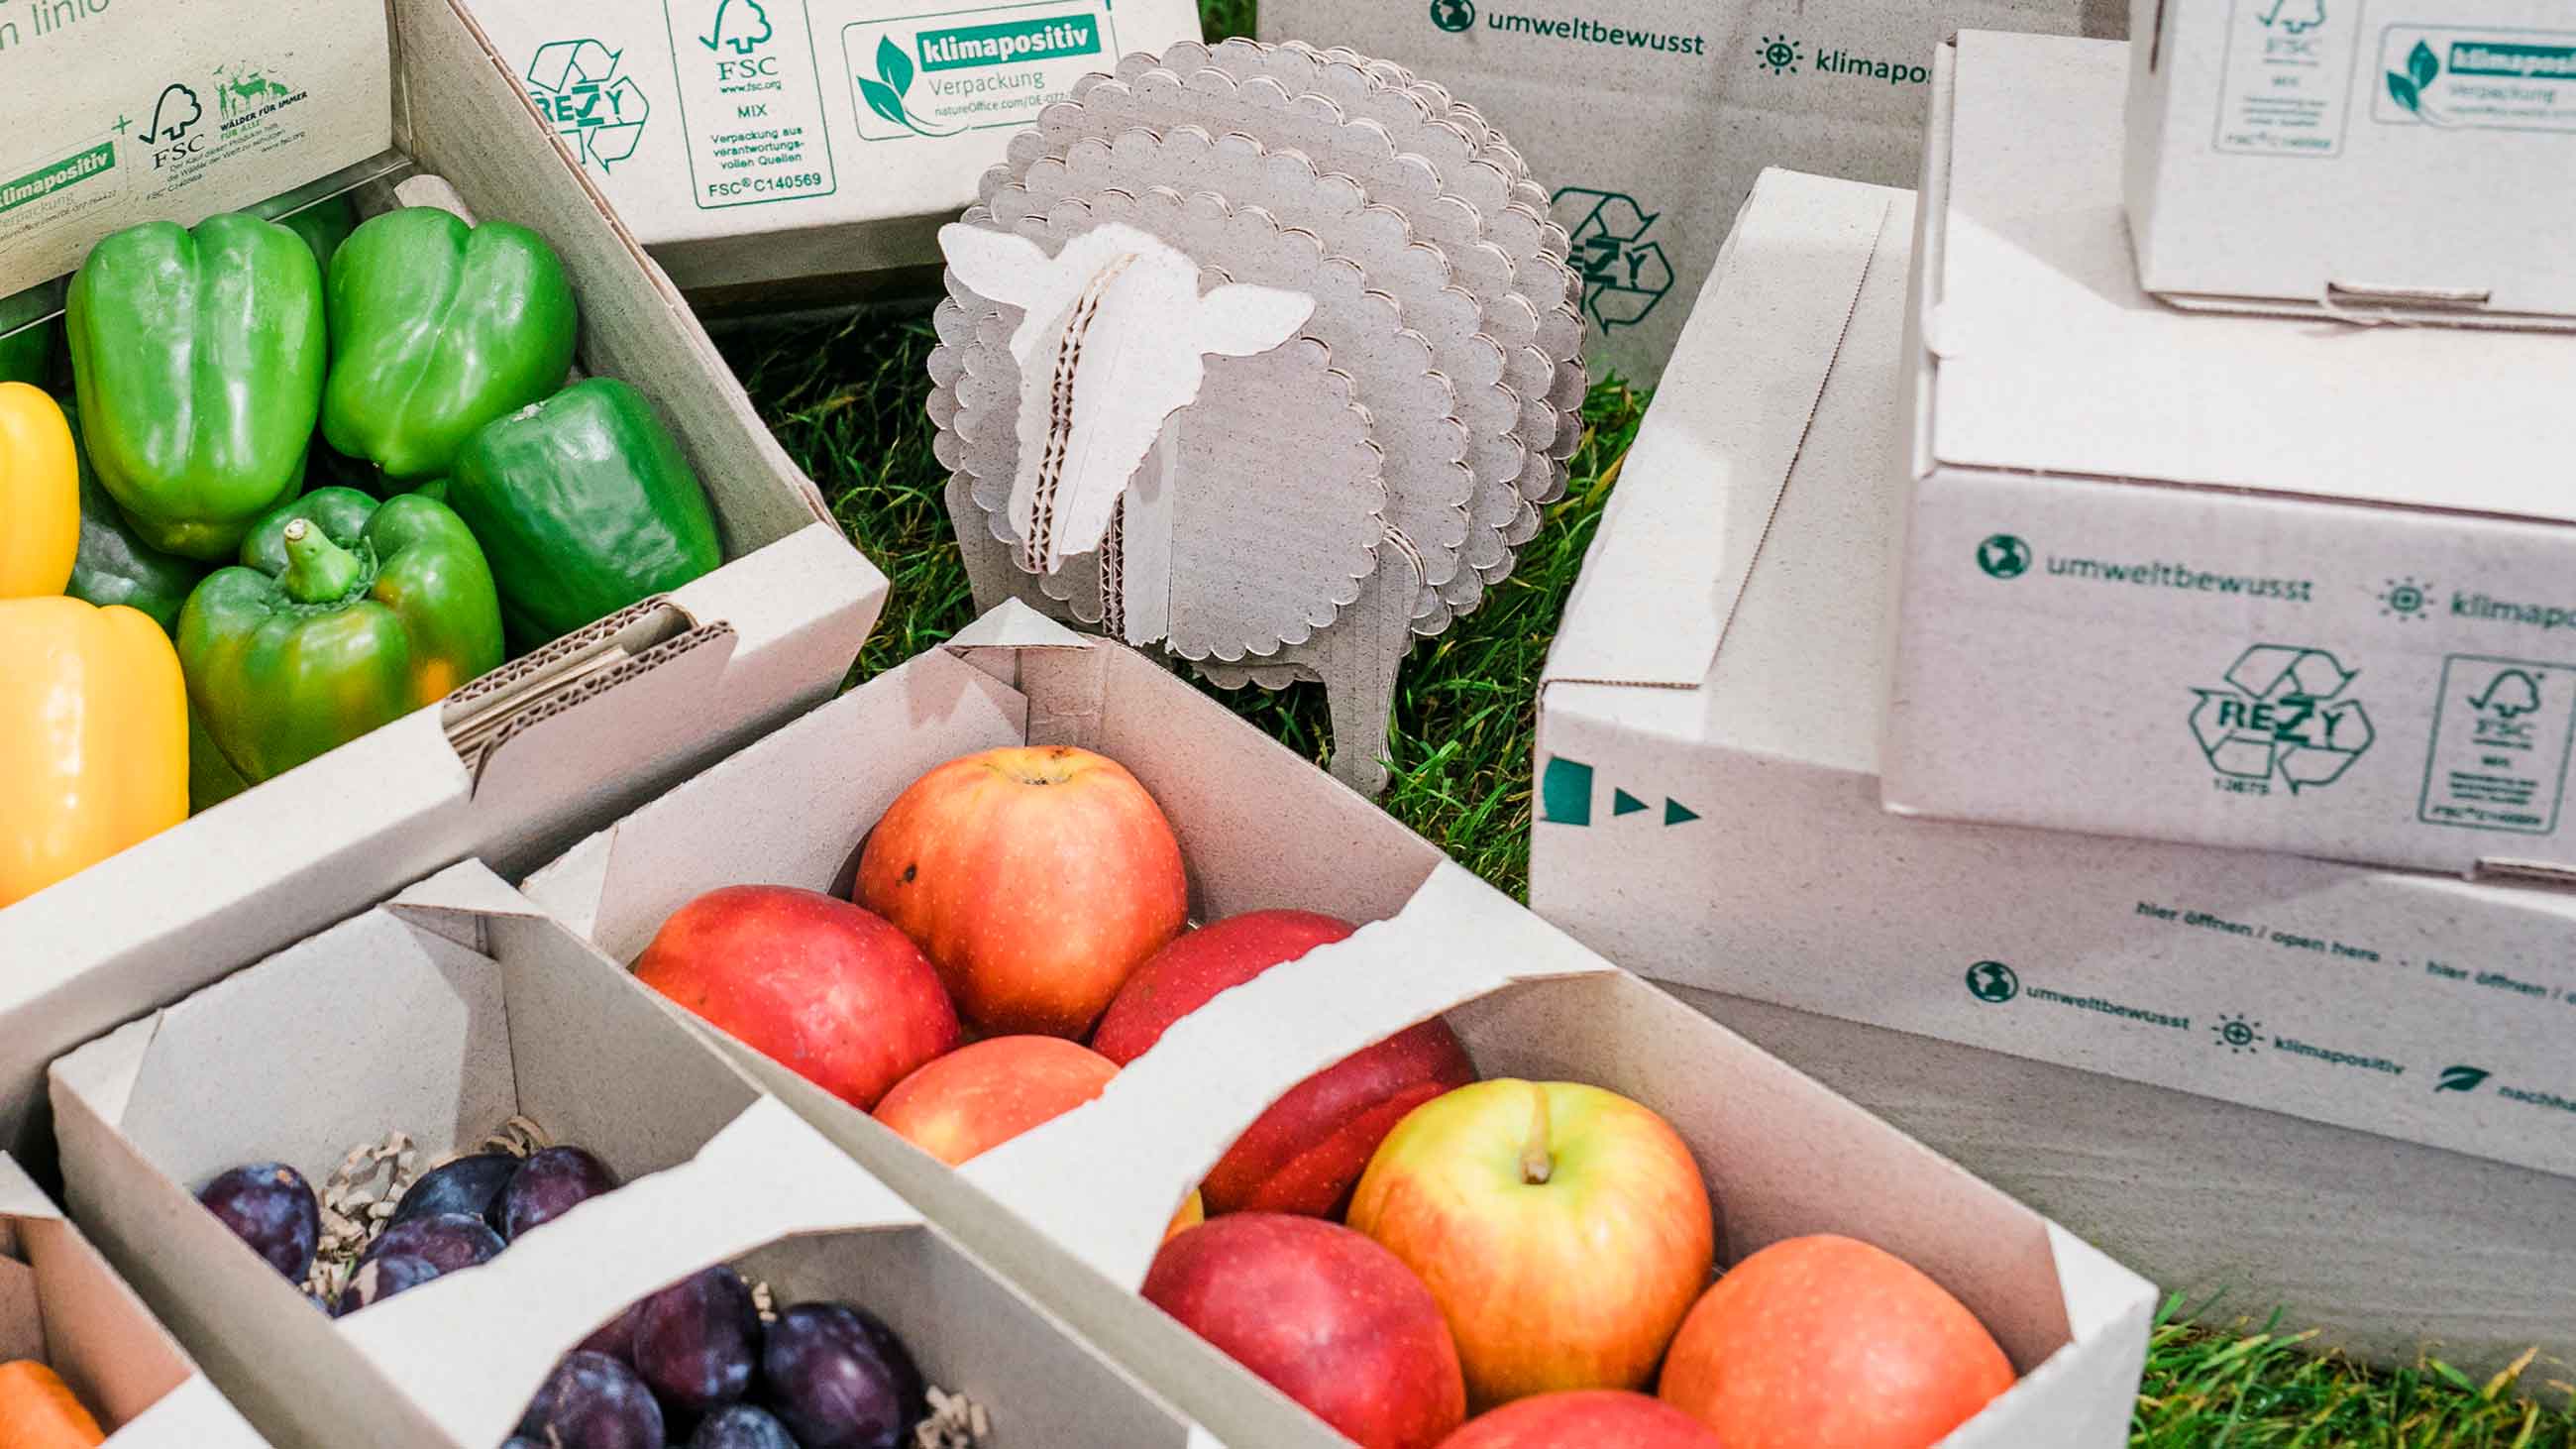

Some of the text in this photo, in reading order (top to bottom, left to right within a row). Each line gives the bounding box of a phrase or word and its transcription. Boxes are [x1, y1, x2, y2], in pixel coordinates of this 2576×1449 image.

[921, 24, 1089, 63] klimapositiv
[1488, 12, 1705, 56] umweltbewusst
[716, 56, 779, 81] FSC
[928, 71, 1046, 97] Verpackung
[278, 91, 307, 108] IMMER
[719, 79, 782, 94] www.fsc.org
[737, 103, 768, 118] MIX
[710, 126, 804, 144] Verpackung aus
[152, 134, 205, 170] FSC
[721, 152, 802, 169] vollen Quellen
[0, 153, 108, 209] limapositiv
[753, 171, 821, 192] C140569
[2047, 553, 2313, 603] umweltbewusst
[2136, 901, 2179, 921] hier
[2184, 910, 2253, 937] öffnen
[2271, 932, 2326, 952] open
[2330, 942, 2381, 963] here
[2426, 959, 2469, 980] hier
[2475, 969, 2547, 997] öffnen
[2026, 986, 2190, 1031] umweltbewusst
[2275, 1036, 2406, 1075] klimapositiv
